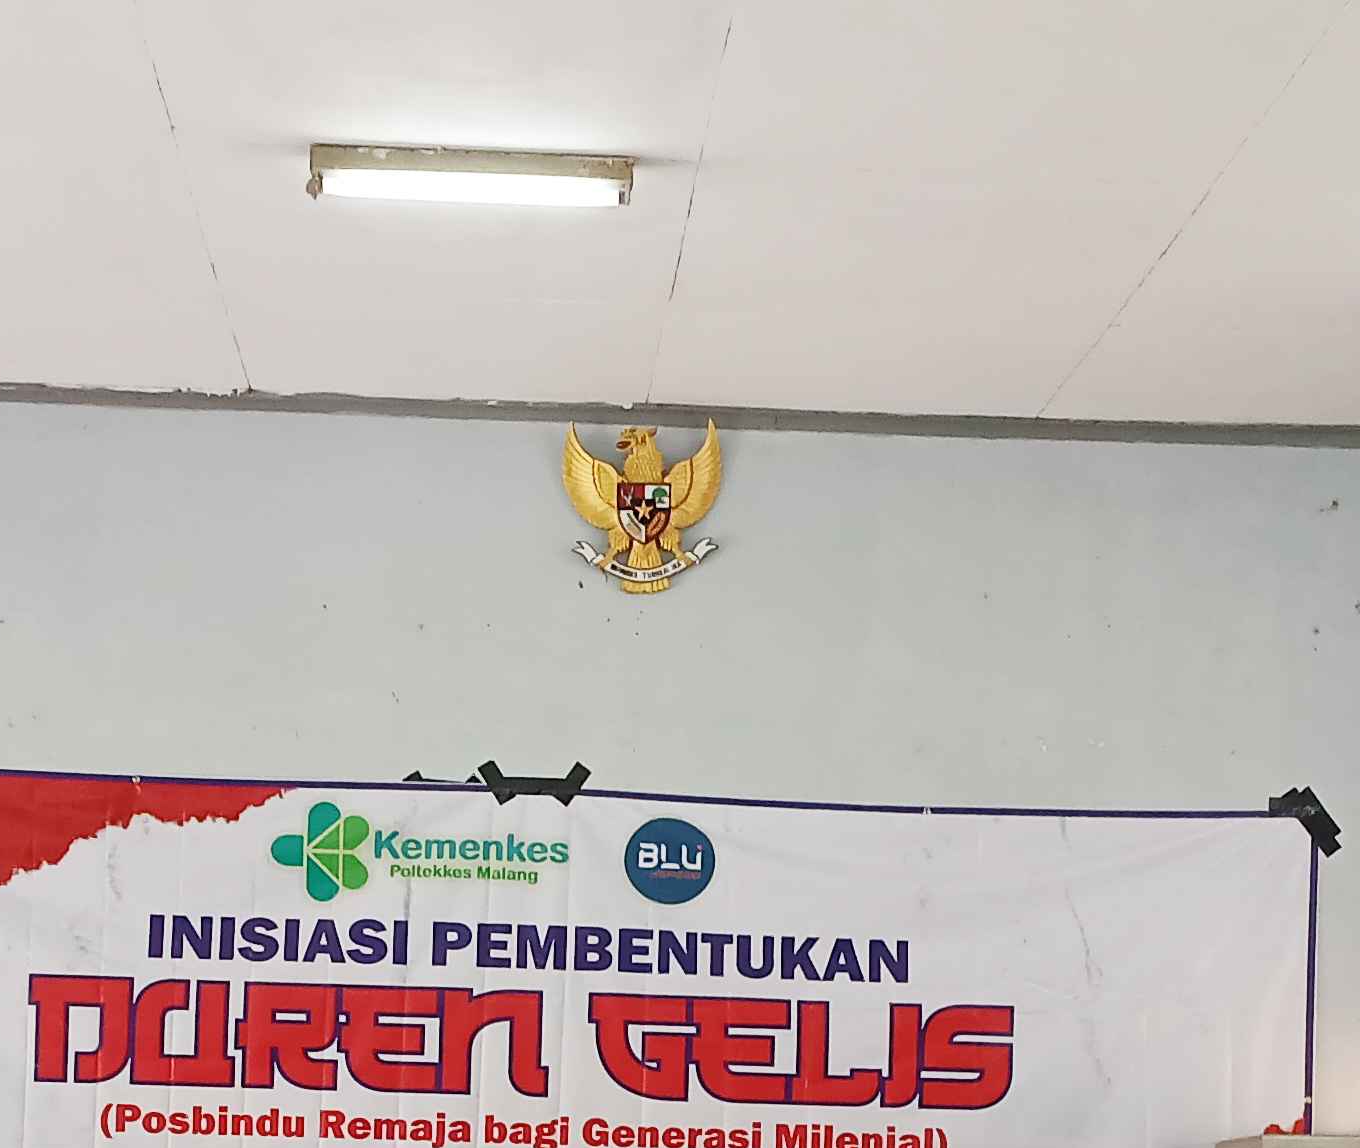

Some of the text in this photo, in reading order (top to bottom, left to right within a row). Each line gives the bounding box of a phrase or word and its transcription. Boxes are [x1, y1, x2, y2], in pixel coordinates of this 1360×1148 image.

[374, 830, 569, 864] Kemenkes
[638, 842, 704, 871] BLU
[390, 864, 539, 885] Poltekkes Malang
[148, 914, 910, 984] INISIASI PEMBENTUKAN
[29, 973, 1014, 1109] DUREN GELIS
[100, 1104, 304, 1138] (Posbindu
[320, 1109, 471, 1148] Remaja
